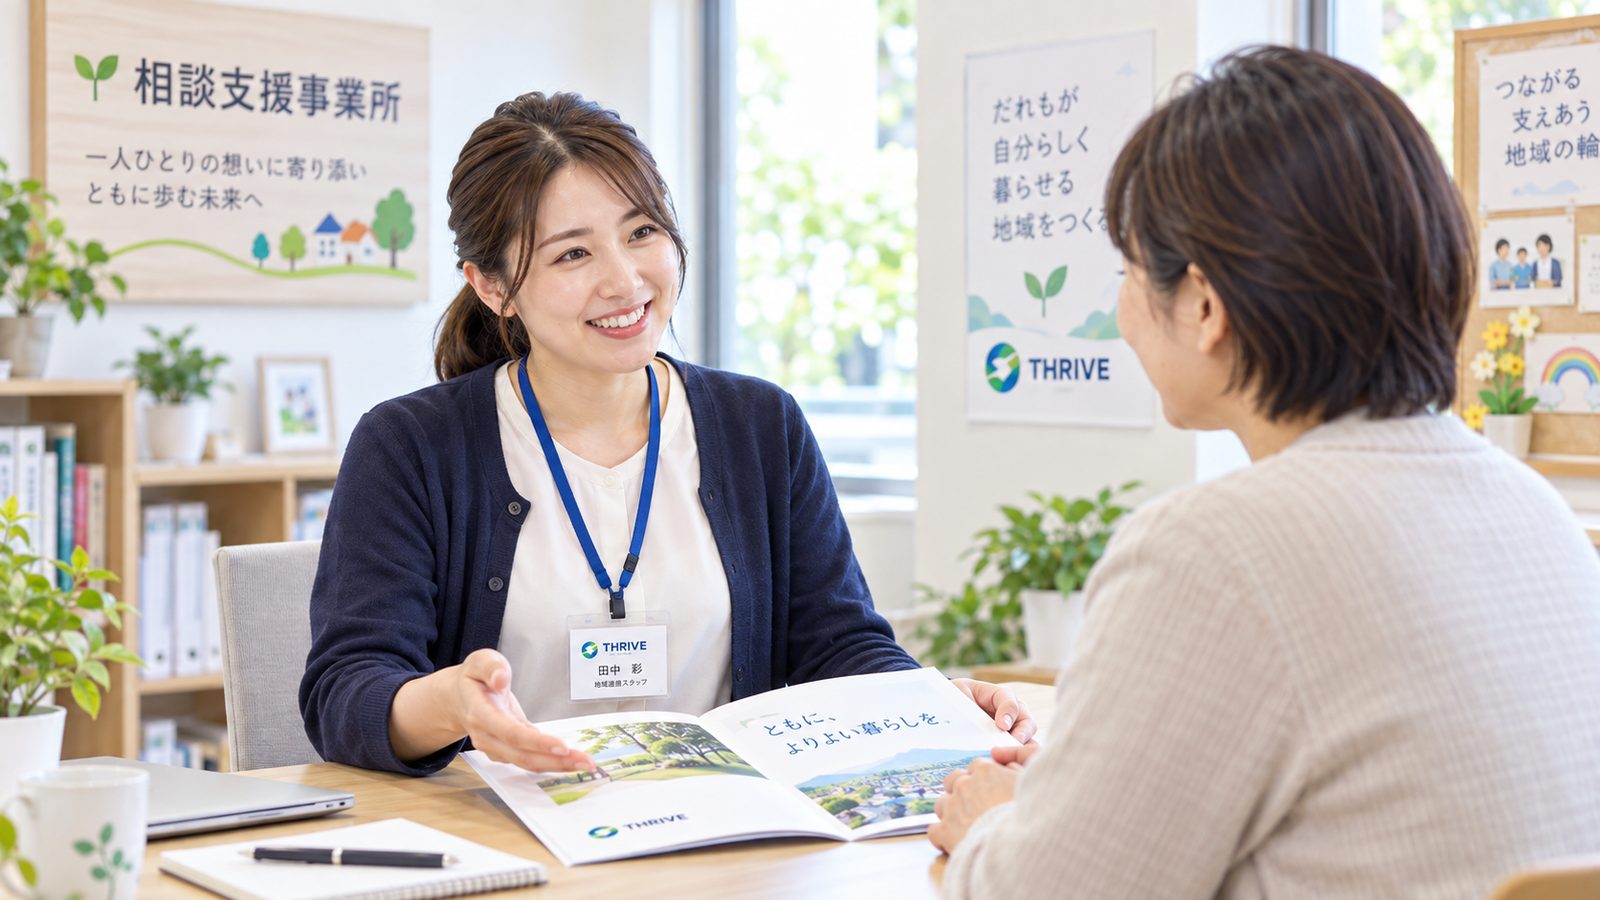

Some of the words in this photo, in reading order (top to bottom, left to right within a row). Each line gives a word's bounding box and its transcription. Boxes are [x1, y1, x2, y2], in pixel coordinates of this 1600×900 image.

[134, 57, 401, 122] 相談支援事業所
[1495, 67, 1581, 100] つながる
[993, 86, 1079, 124] だれもが
[1512, 99, 1591, 133] 支えあう
[994, 126, 1089, 164] 自分らしく
[1504, 132, 1600, 167] 地域の輪
[85, 146, 367, 181] 一人ひとりの想いに寄り添い
[87, 181, 263, 211] ともに歩む未来へ
[993, 170, 1074, 204] 暮らせる
[1029, 358, 1110, 381] THRIVE
[603, 641, 647, 652] THRIVE
[599, 664, 620, 676] 田中
[631, 663, 643, 675] 彩
[764, 713, 836, 736] ともに、
[623, 814, 688, 830] THRIVE
